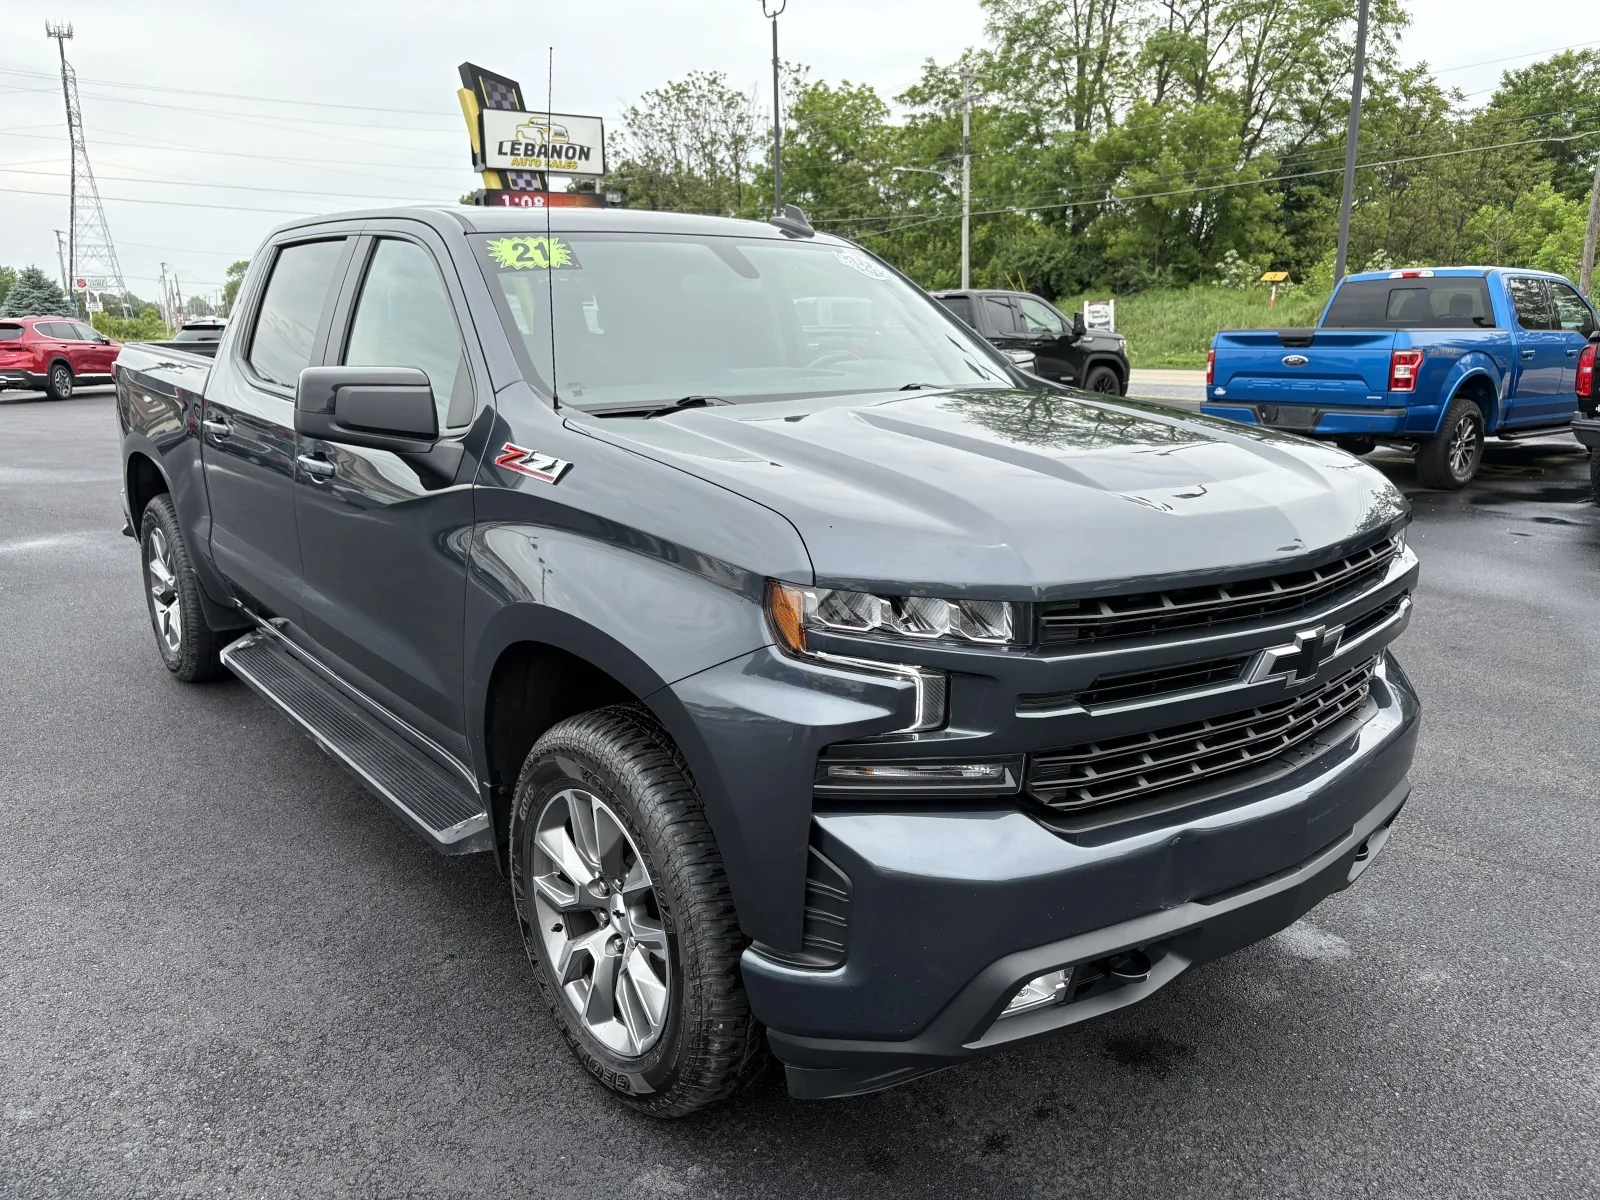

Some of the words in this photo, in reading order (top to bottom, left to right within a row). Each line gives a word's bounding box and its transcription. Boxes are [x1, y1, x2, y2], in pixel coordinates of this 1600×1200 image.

[498, 141, 591, 161] LEBANON
[511, 157, 542, 168] AUTO
[545, 158, 578, 170] SALES
[511, 241, 550, 263] 21
[494, 442, 574, 486] Z71
[580, 765, 672, 936] YOKOHAMA
